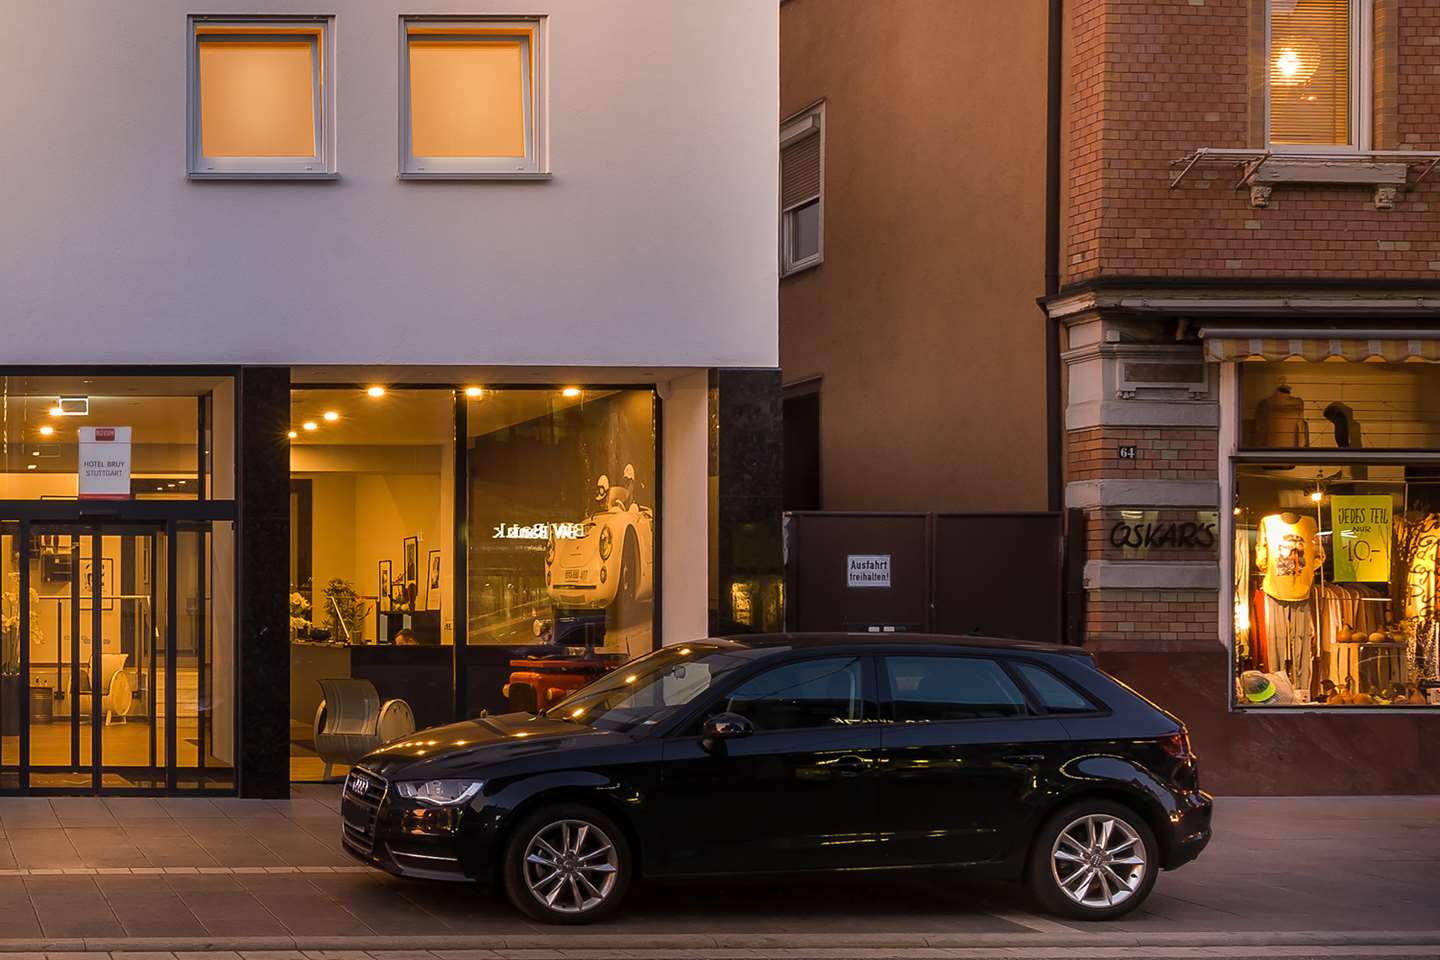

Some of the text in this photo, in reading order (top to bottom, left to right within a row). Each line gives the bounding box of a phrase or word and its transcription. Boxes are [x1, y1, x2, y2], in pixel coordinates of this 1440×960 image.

[1120, 447, 1135, 458] 64
[1338, 507, 1389, 524] JEDES TEIL
[1342, 540, 1380, 562] 10,-
[850, 560, 887, 570] Ausfahrt
[849, 572, 889, 581] freihalten!
